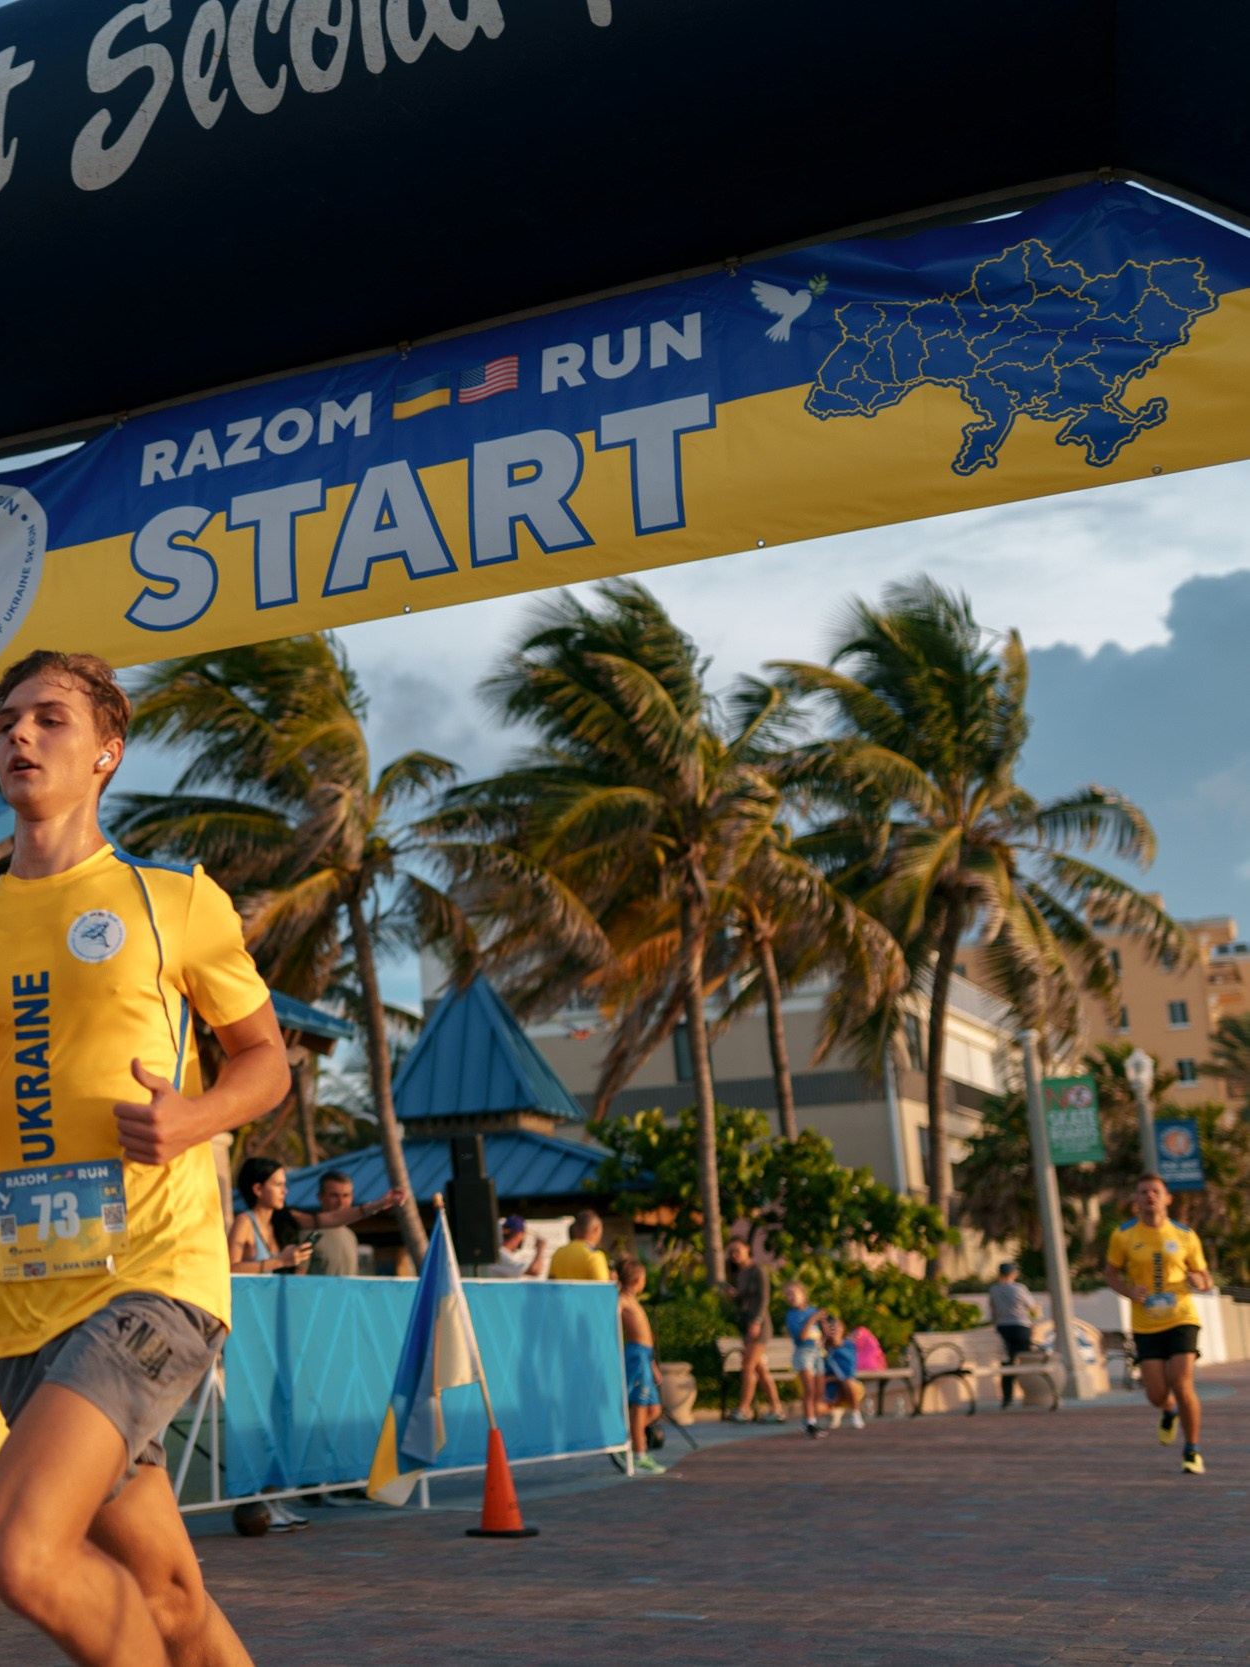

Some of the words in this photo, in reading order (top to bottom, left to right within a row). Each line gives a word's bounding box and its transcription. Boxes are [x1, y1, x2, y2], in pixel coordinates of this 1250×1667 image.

[140, 391, 373, 486] RAZOM
[541, 311, 703, 395] RUN
[124, 392, 718, 633] START
[3, 566, 31, 622] UKRAINE
[13, 970, 56, 1163] UKRAINE
[5, 1172, 48, 1188] RAZOM
[77, 1166, 109, 1180] RUN
[31, 1191, 81, 1241] 73
